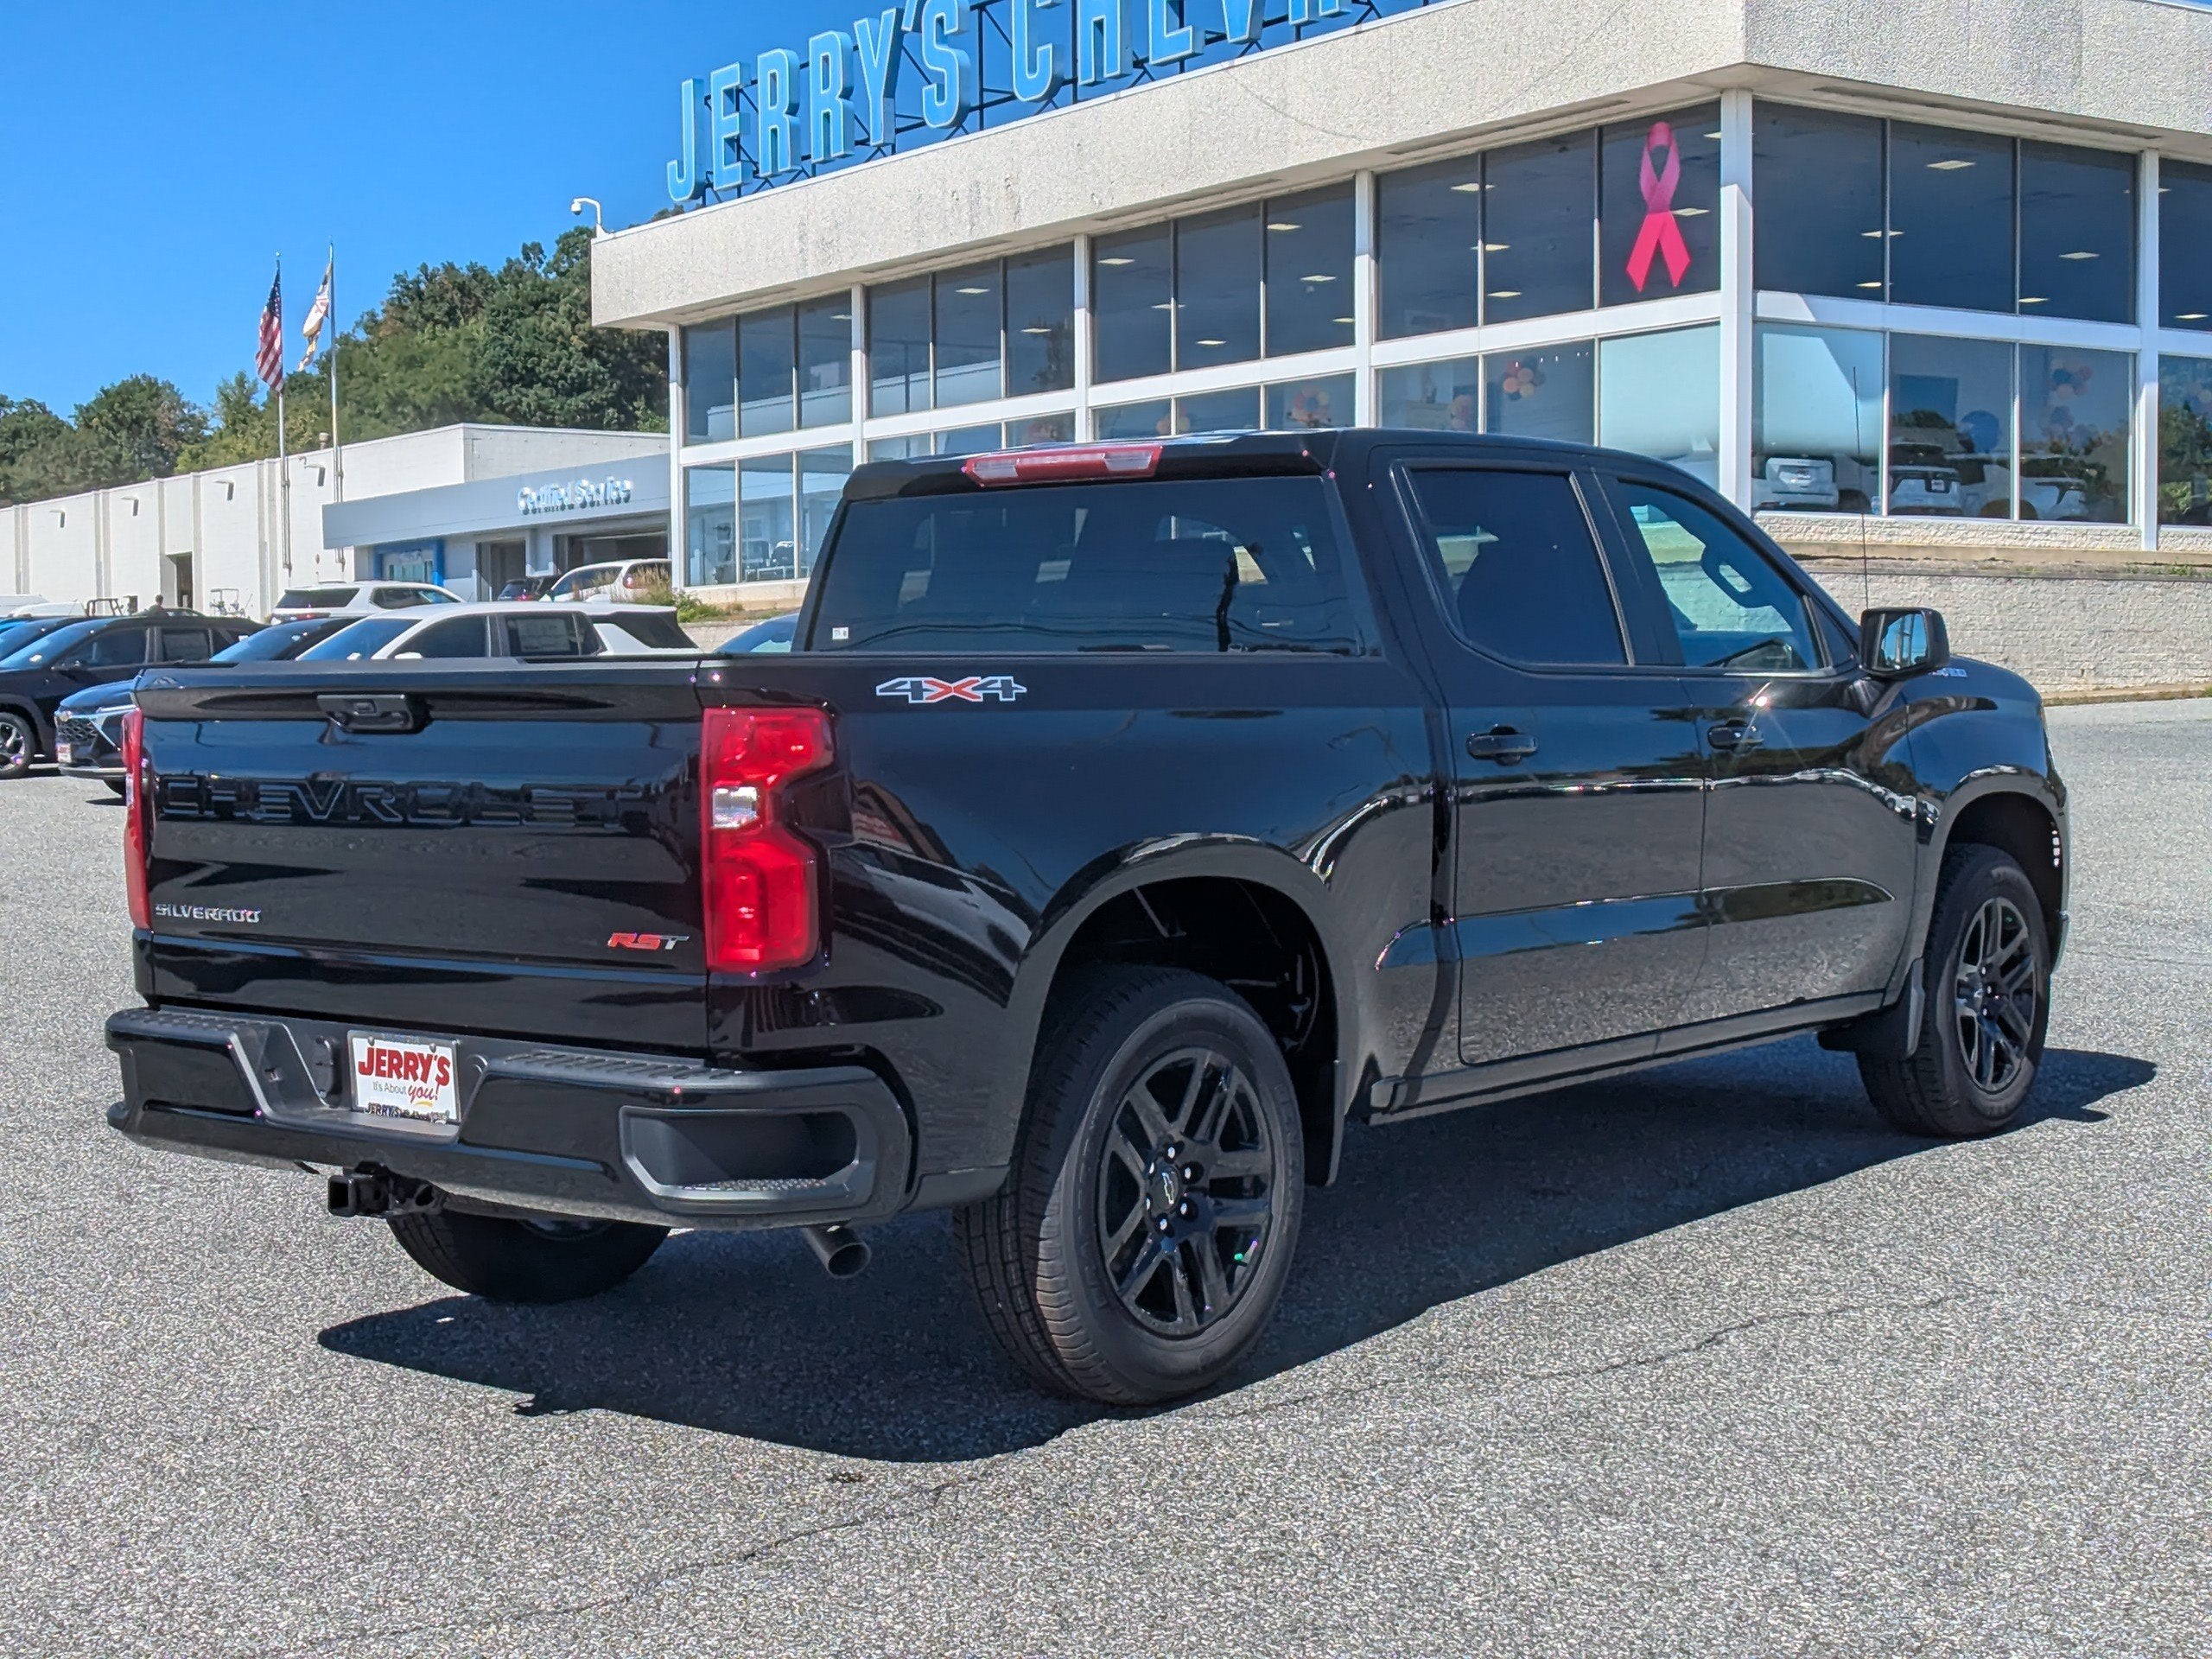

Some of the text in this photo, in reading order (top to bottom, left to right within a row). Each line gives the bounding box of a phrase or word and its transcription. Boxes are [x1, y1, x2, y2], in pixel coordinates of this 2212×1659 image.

[666, 0, 968, 202] JERRY'S
[156, 903, 261, 924] SILVERADO
[607, 932, 690, 950] RST
[359, 1047, 451, 1087] JERRY'S
[385, 1084, 407, 1095] About
[408, 1084, 439, 1103] you!
